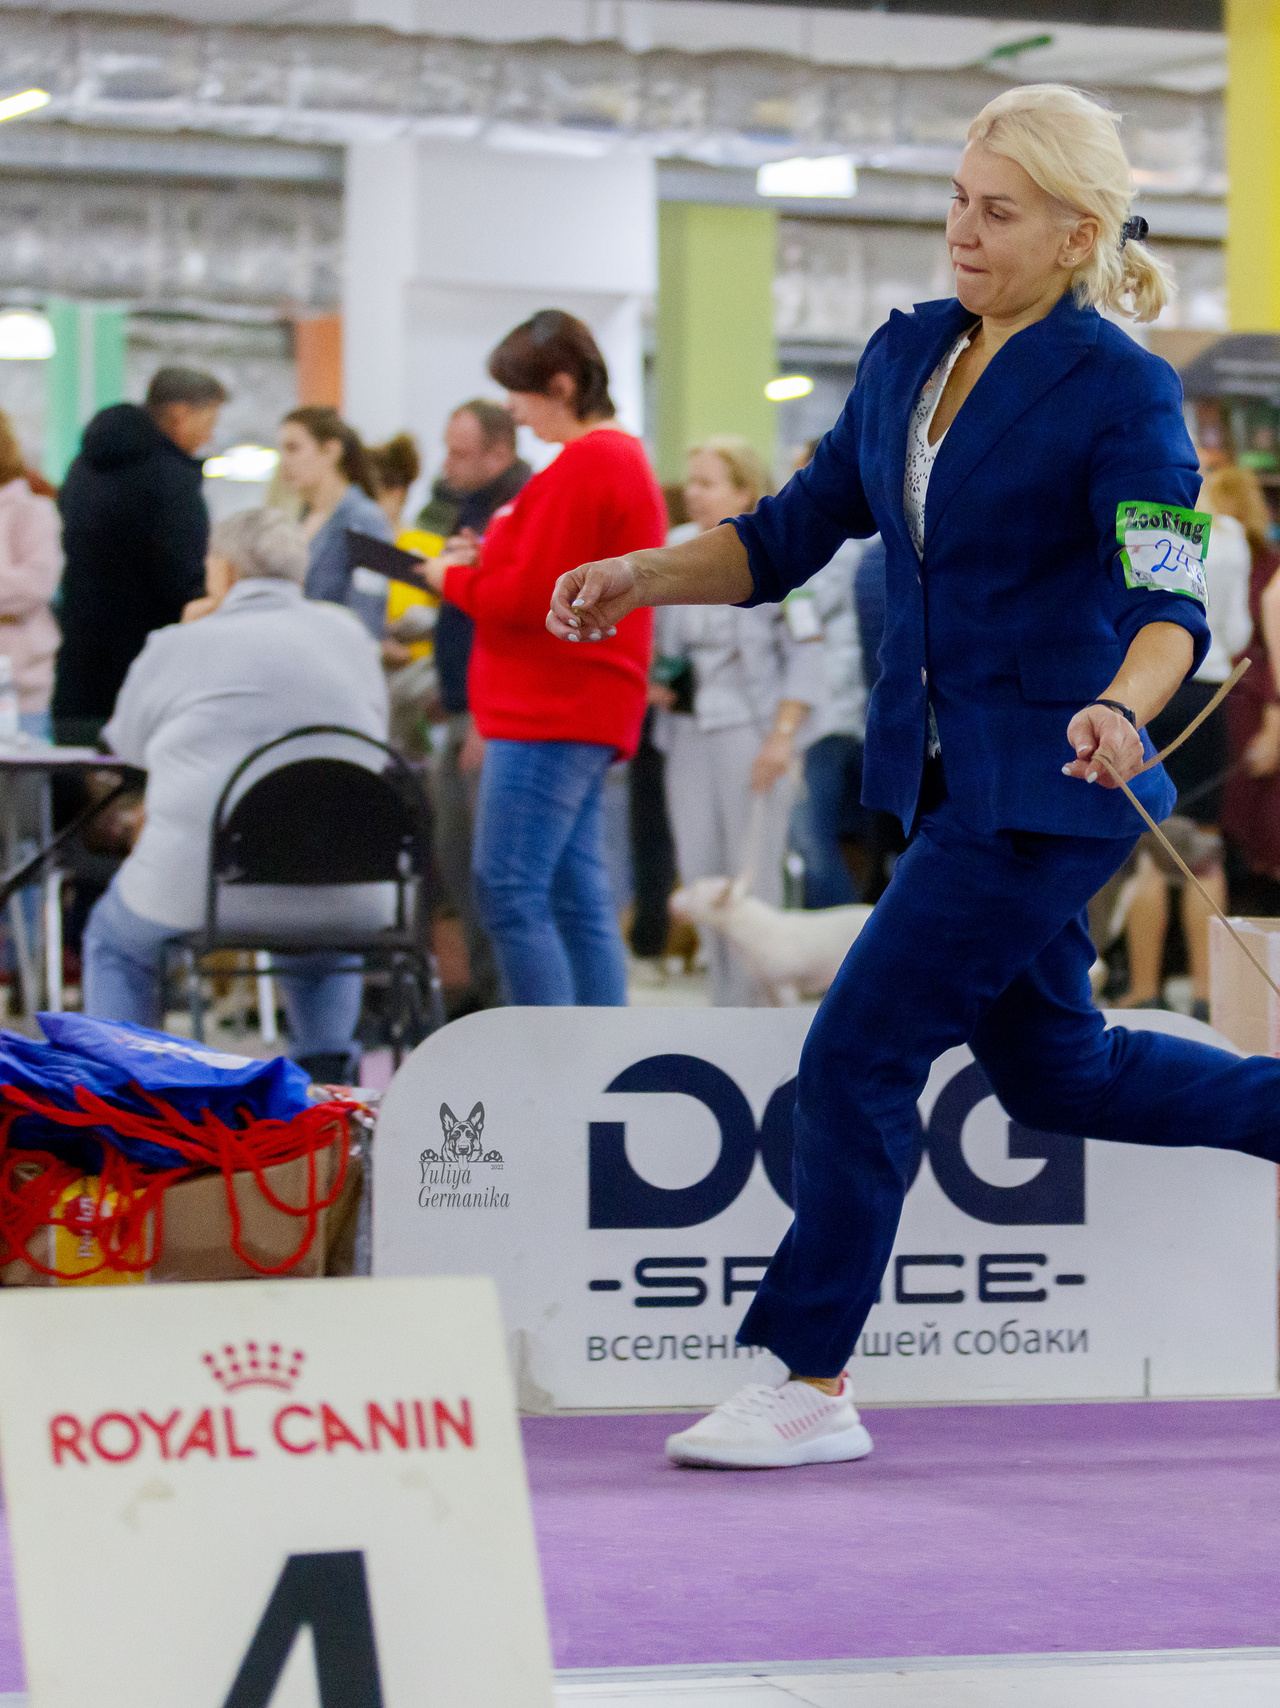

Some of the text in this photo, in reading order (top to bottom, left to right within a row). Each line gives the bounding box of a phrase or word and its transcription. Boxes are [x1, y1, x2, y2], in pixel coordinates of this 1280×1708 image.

[588, 1053, 1086, 1229] DG
[852, 1321, 941, 1357] шей
[954, 1320, 1089, 1356] собаки
[48, 1397, 477, 1467] ROYAL CANIN
